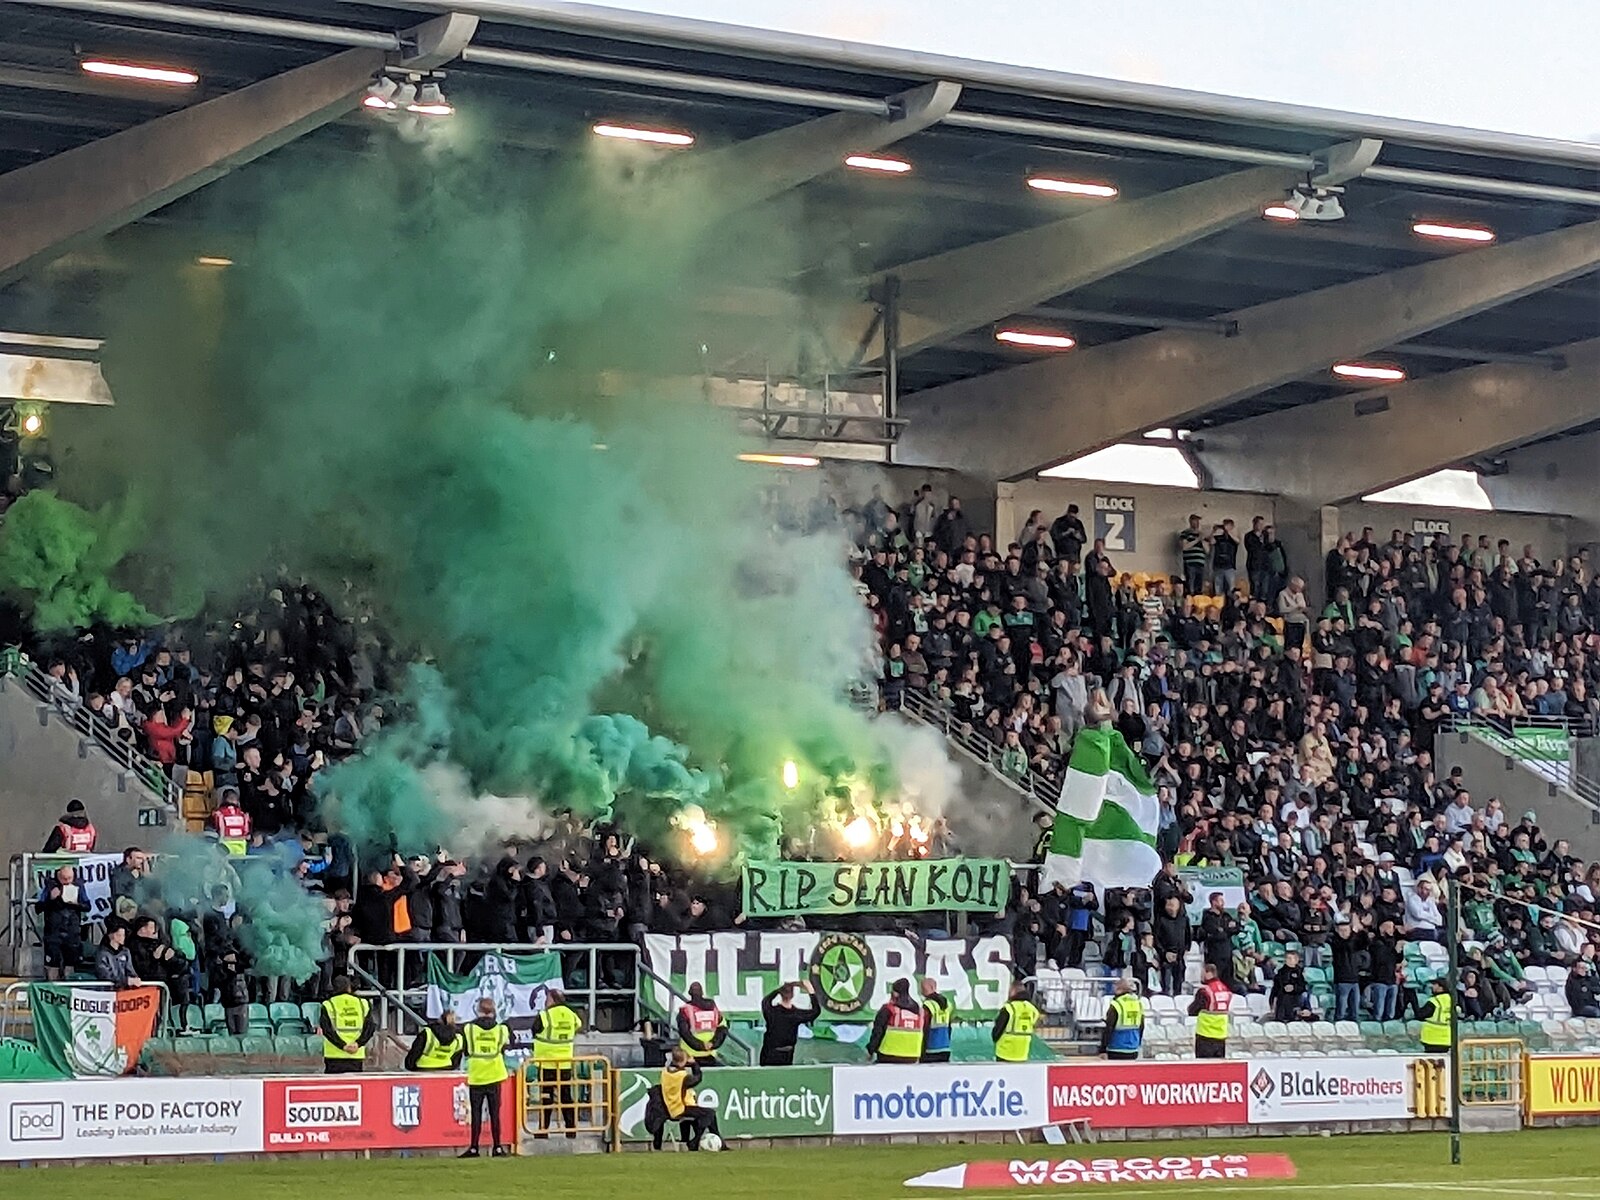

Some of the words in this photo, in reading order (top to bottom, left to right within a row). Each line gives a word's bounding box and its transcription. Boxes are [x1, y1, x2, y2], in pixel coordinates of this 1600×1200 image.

[1095, 496, 1135, 511] BLOCK
[828, 866, 918, 907] SEAN
[853, 1078, 1024, 1119] motorfix.ie
[1140, 1081, 1244, 1106] WORKWEAR
[72, 1104, 108, 1121] THE
[115, 1102, 154, 1120] POD
[161, 1100, 242, 1119] FACTORY
[288, 1105, 360, 1123] SOUDAL
[724, 1086, 830, 1126] Airtricity
[76, 1127, 115, 1139] Leading
[117, 1125, 157, 1137] Ireland's
[160, 1124, 198, 1135] Modular
[200, 1123, 237, 1136] Industry
[269, 1132, 304, 1144] BUILD
[305, 1131, 330, 1143] THE
[1010, 1167, 1249, 1185] WORKWEAR
